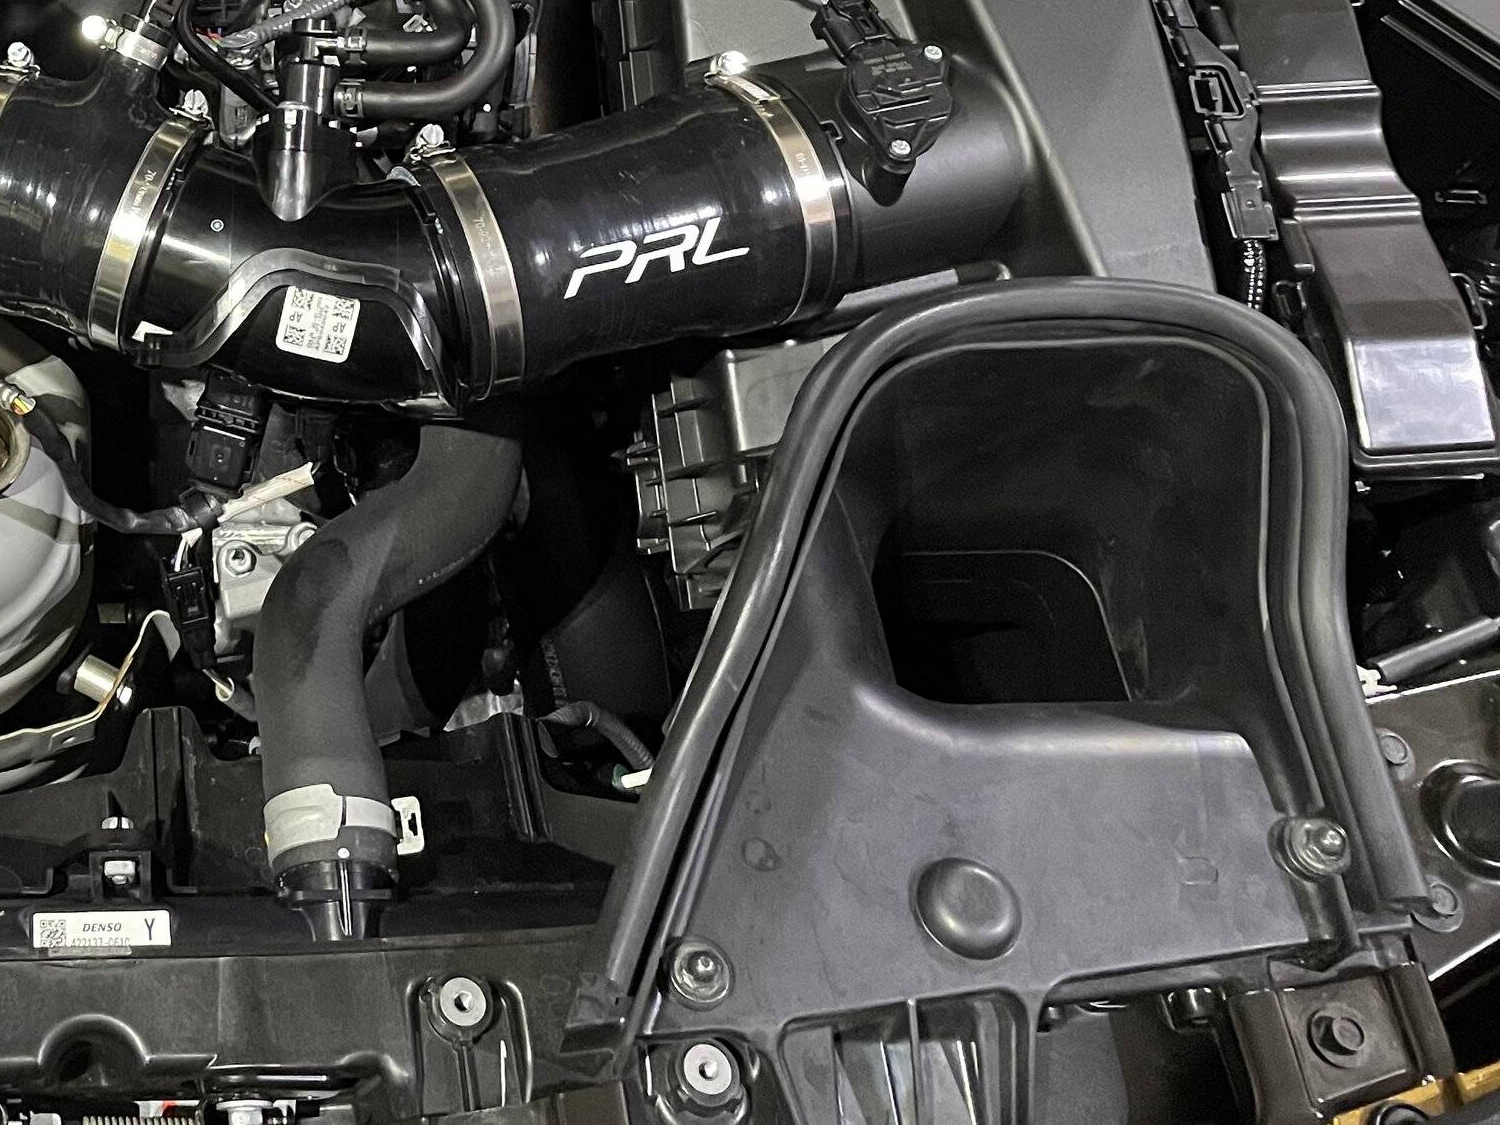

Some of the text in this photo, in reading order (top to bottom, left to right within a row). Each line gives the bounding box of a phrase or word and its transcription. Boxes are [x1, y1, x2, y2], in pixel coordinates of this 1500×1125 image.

[563, 216, 750, 300] PRL
[82, 922, 122, 932] DENSO
[144, 917, 156, 941] Y
